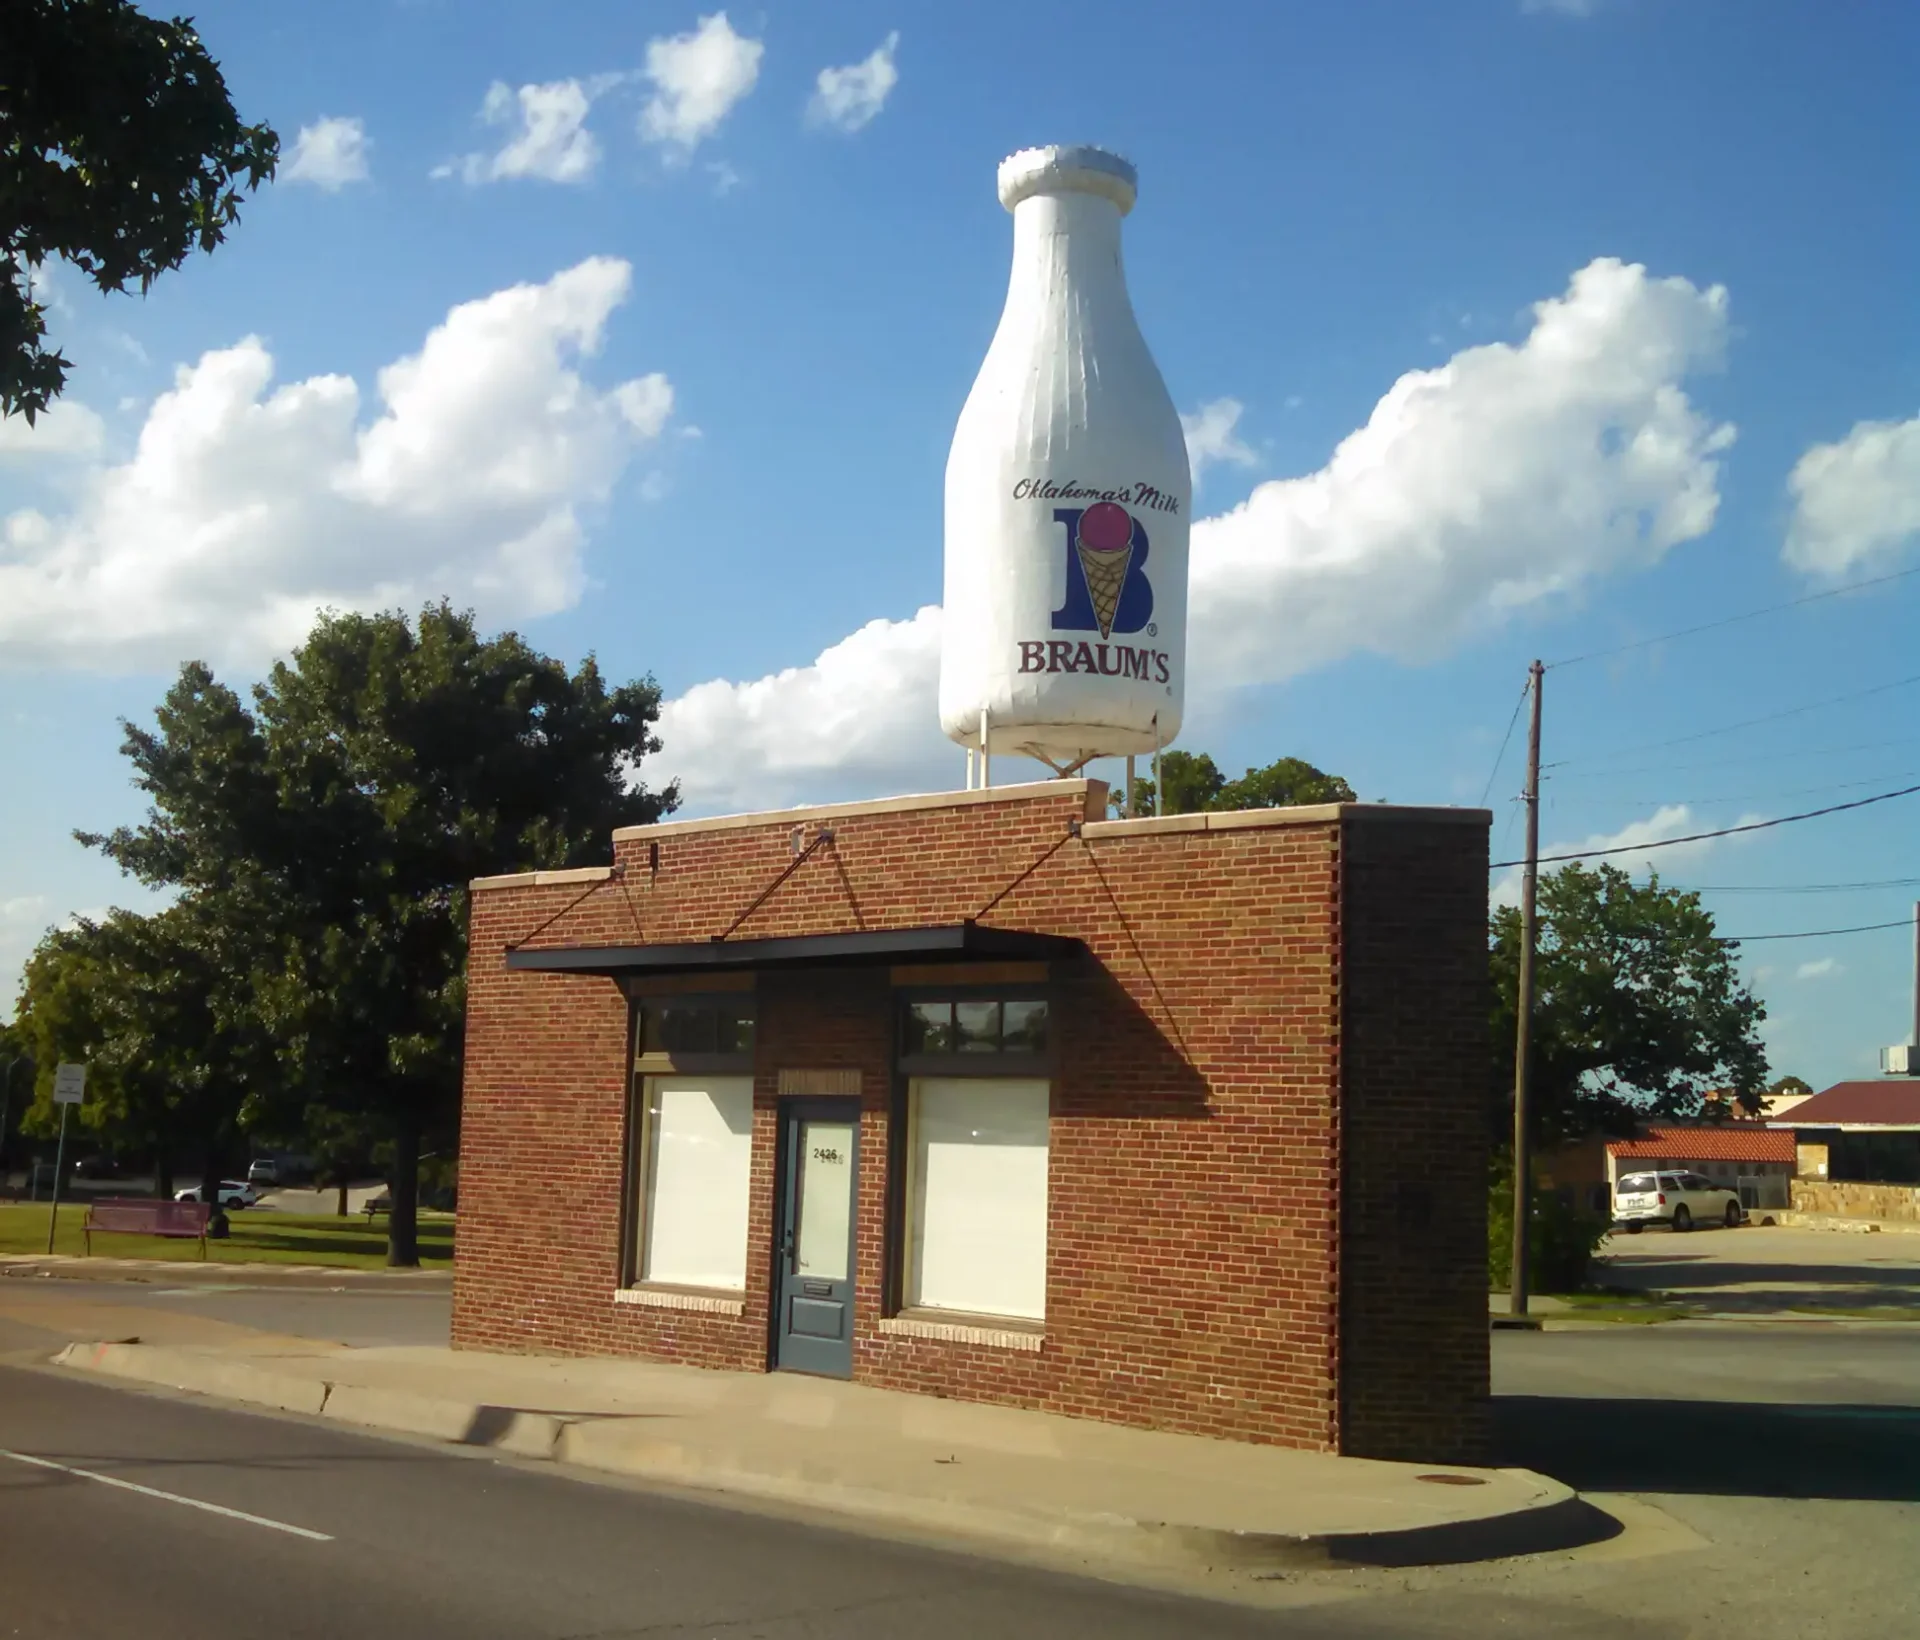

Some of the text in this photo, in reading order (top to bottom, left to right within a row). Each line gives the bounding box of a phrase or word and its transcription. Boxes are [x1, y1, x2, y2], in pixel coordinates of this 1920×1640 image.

[1013, 478, 1180, 515] Oklahoma's Milk
[1017, 640, 1170, 684] BRAUM'S
[813, 1147, 838, 1160] 2426
